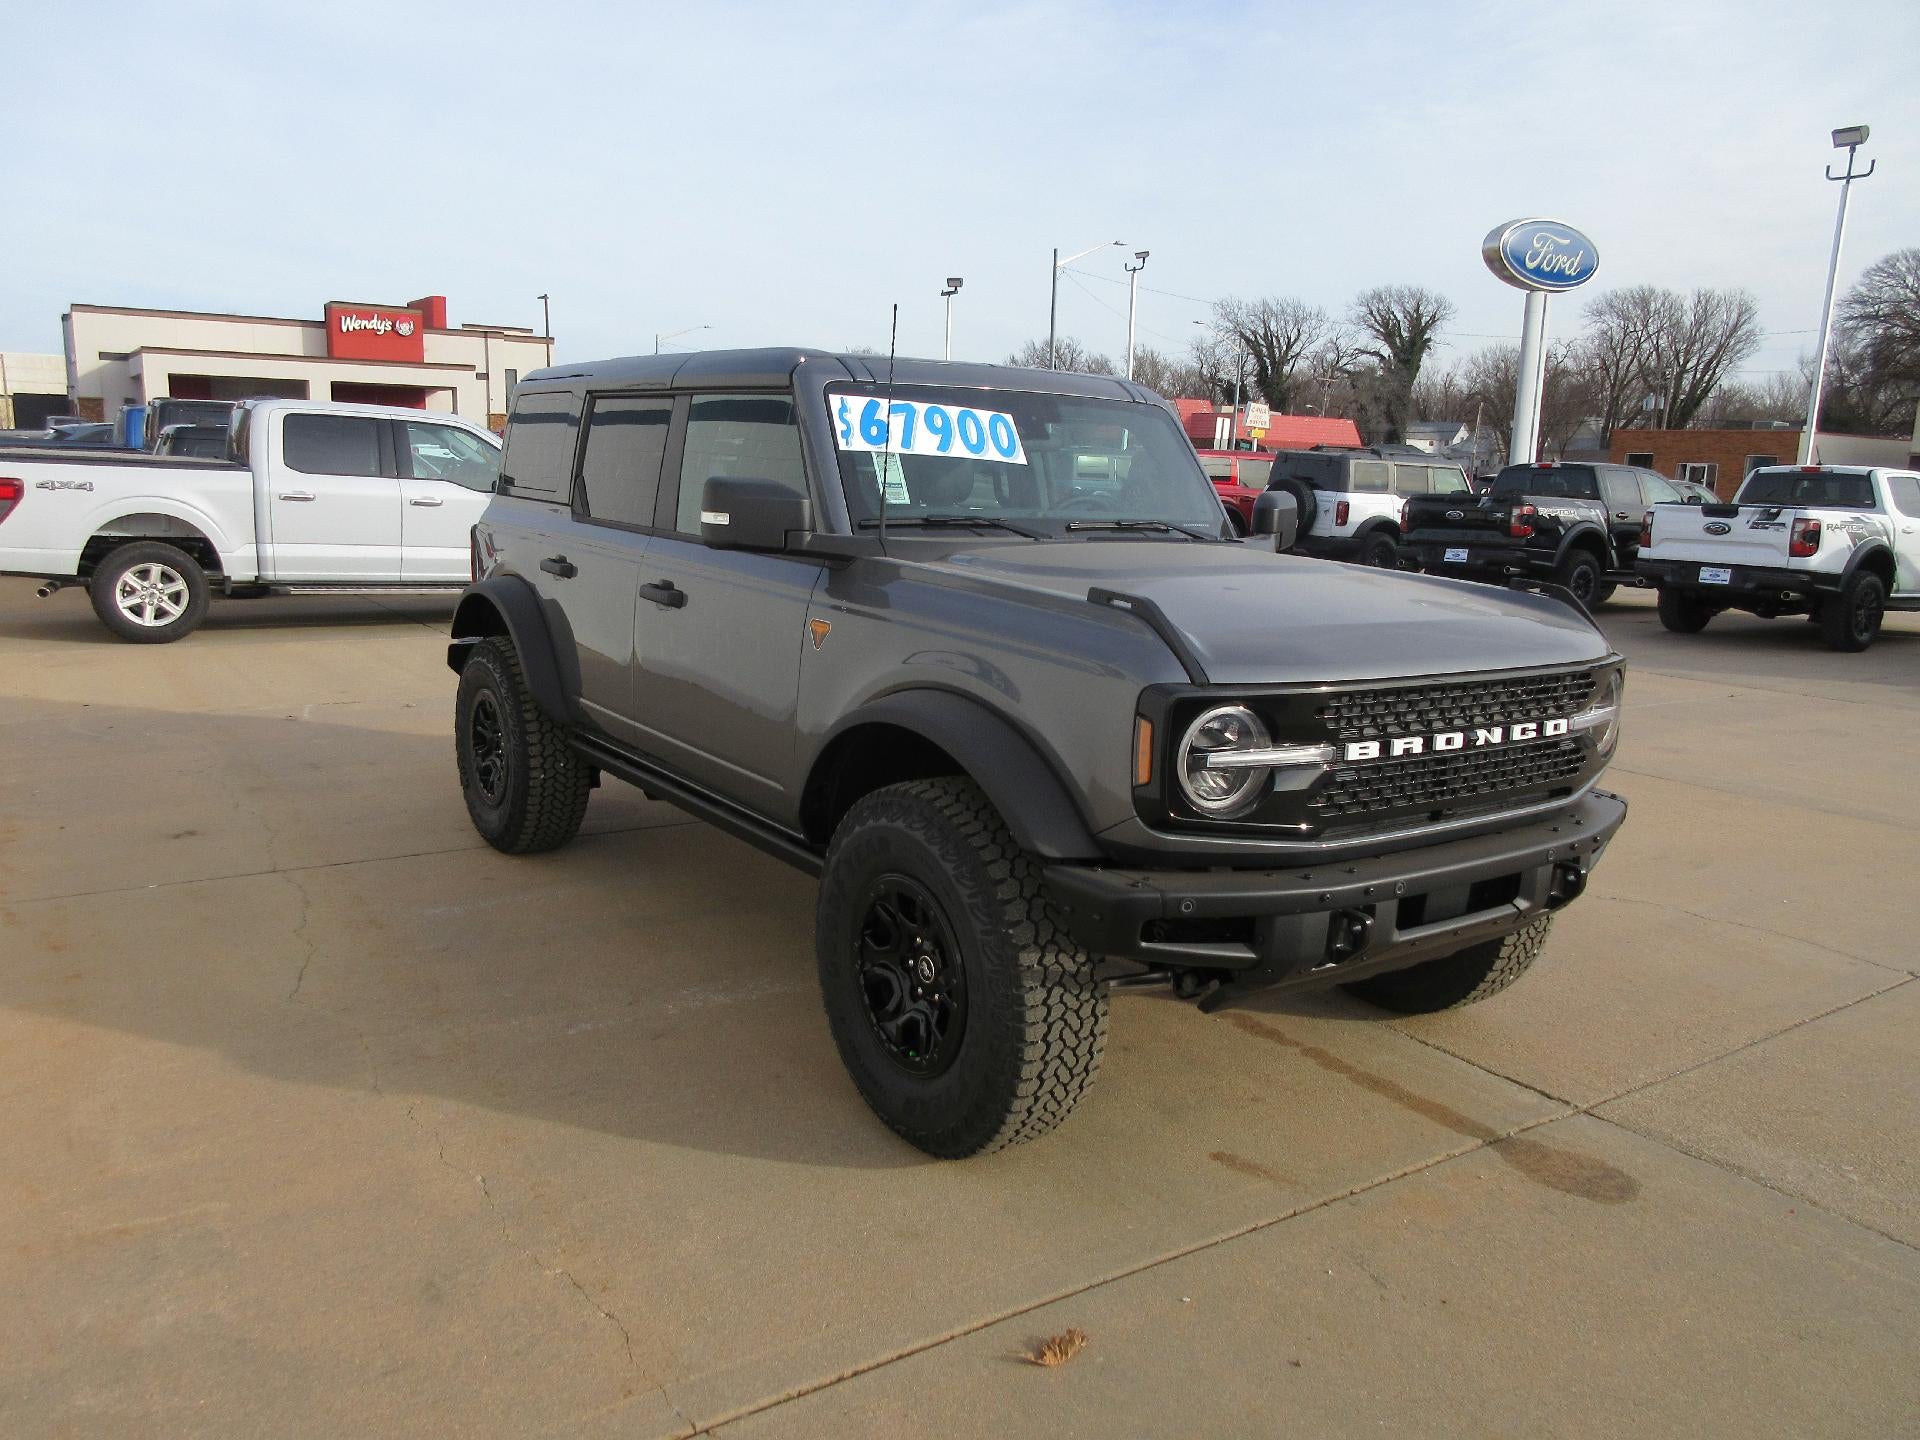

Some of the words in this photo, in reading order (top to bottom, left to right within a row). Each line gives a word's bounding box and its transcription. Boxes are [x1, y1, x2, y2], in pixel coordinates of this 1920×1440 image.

[1525, 231, 1584, 277] Ford
[340, 313, 393, 335] Wendy's
[837, 396, 1019, 460] $67900
[1537, 506, 1580, 520] RAPTOR
[1826, 523, 1868, 536] RAPTOR
[1343, 718, 1568, 761] BRONCO
